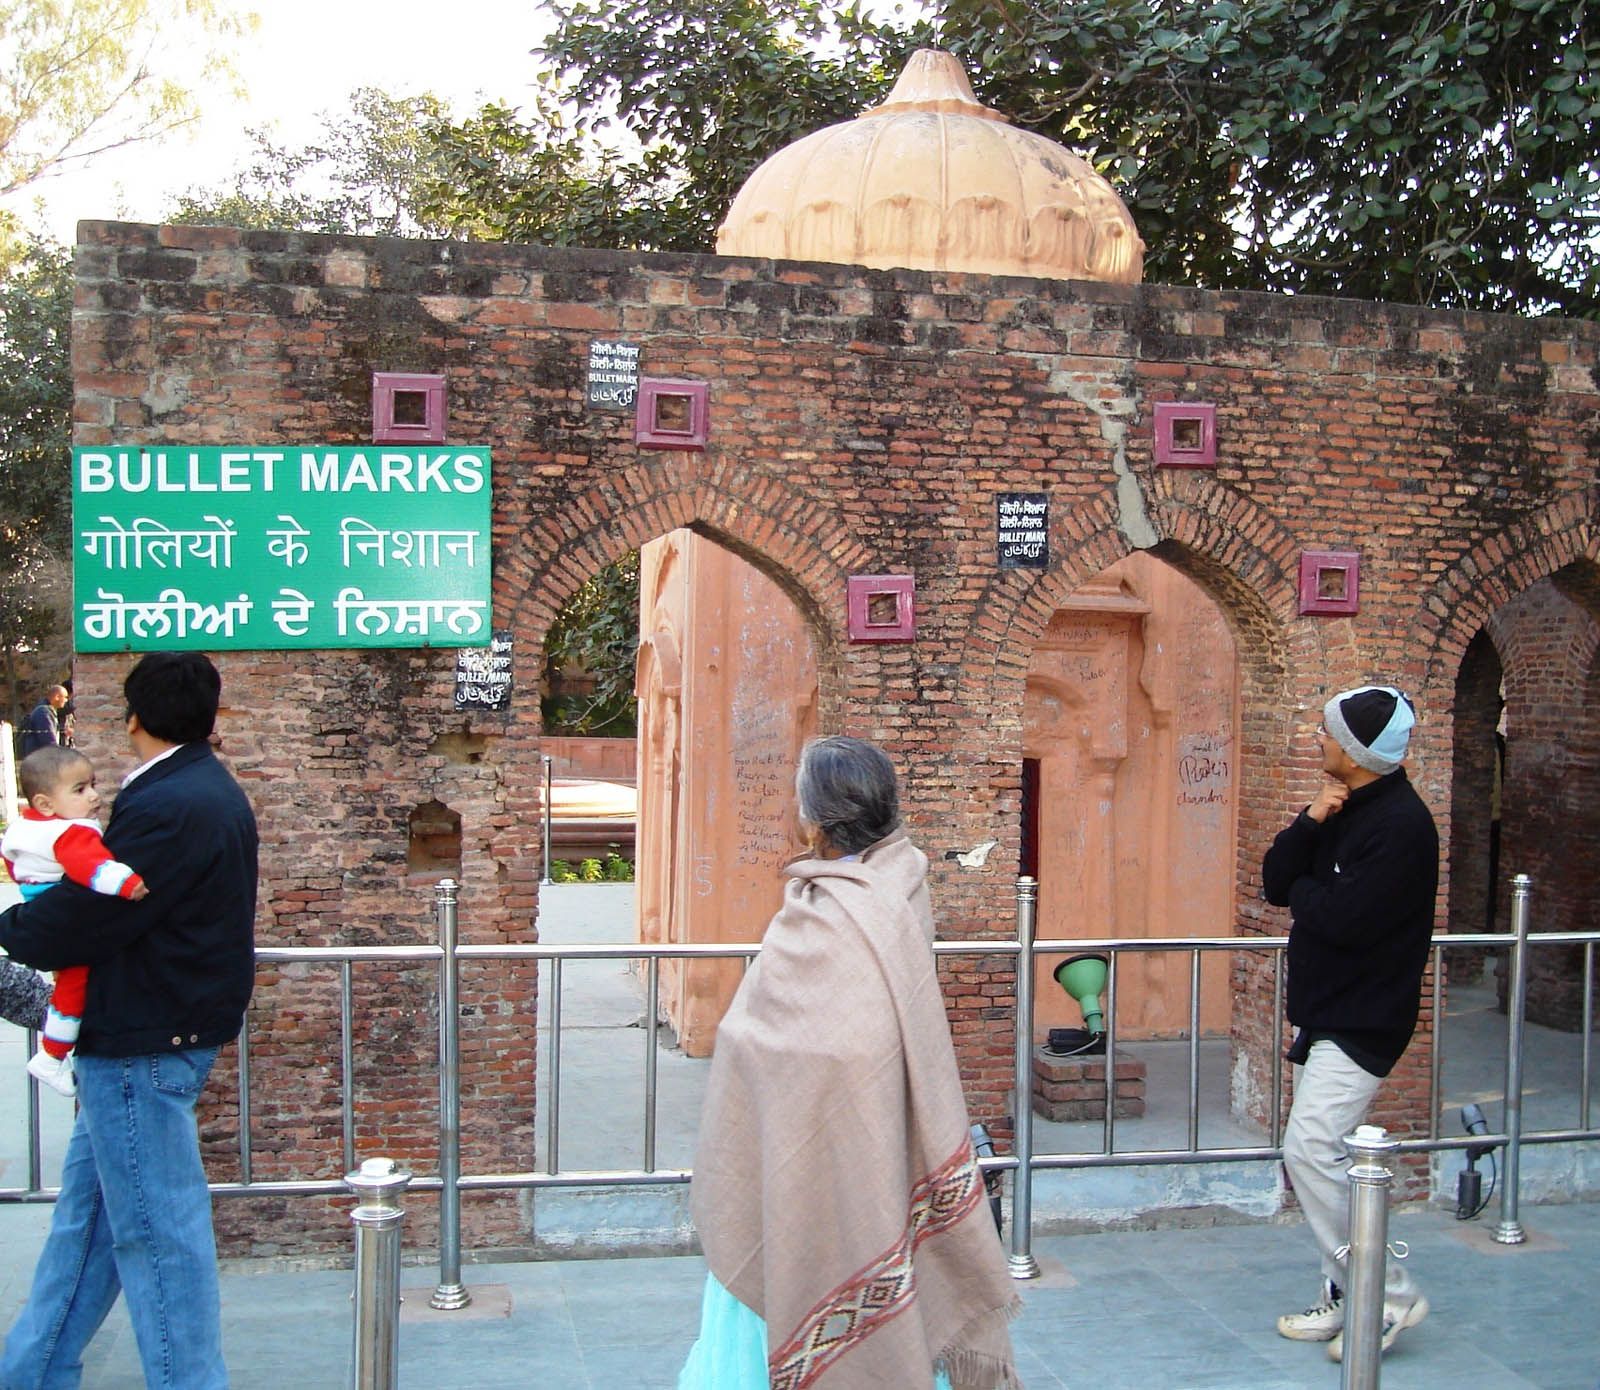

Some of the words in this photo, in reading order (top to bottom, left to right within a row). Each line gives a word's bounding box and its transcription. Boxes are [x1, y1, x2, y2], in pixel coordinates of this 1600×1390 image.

[588, 372, 616, 383] BULLET
[615, 374, 638, 385] MARK
[80, 453, 283, 493] BULLET
[301, 454, 484, 494] MARKS
[81, 515, 238, 569] गोलियों
[266, 515, 311, 568] के
[339, 516, 480, 569] निशान
[998, 532, 1025, 543] BULLET
[1024, 531, 1046, 543] MARK
[82, 587, 254, 639] ਗੋਲੀਆਂ
[271, 588, 315, 637] ਦੇ
[332, 587, 488, 640] ਨਿਸ਼ਾਨ
[457, 671, 487, 683] BULLET
[486, 671, 513, 683] MARK
